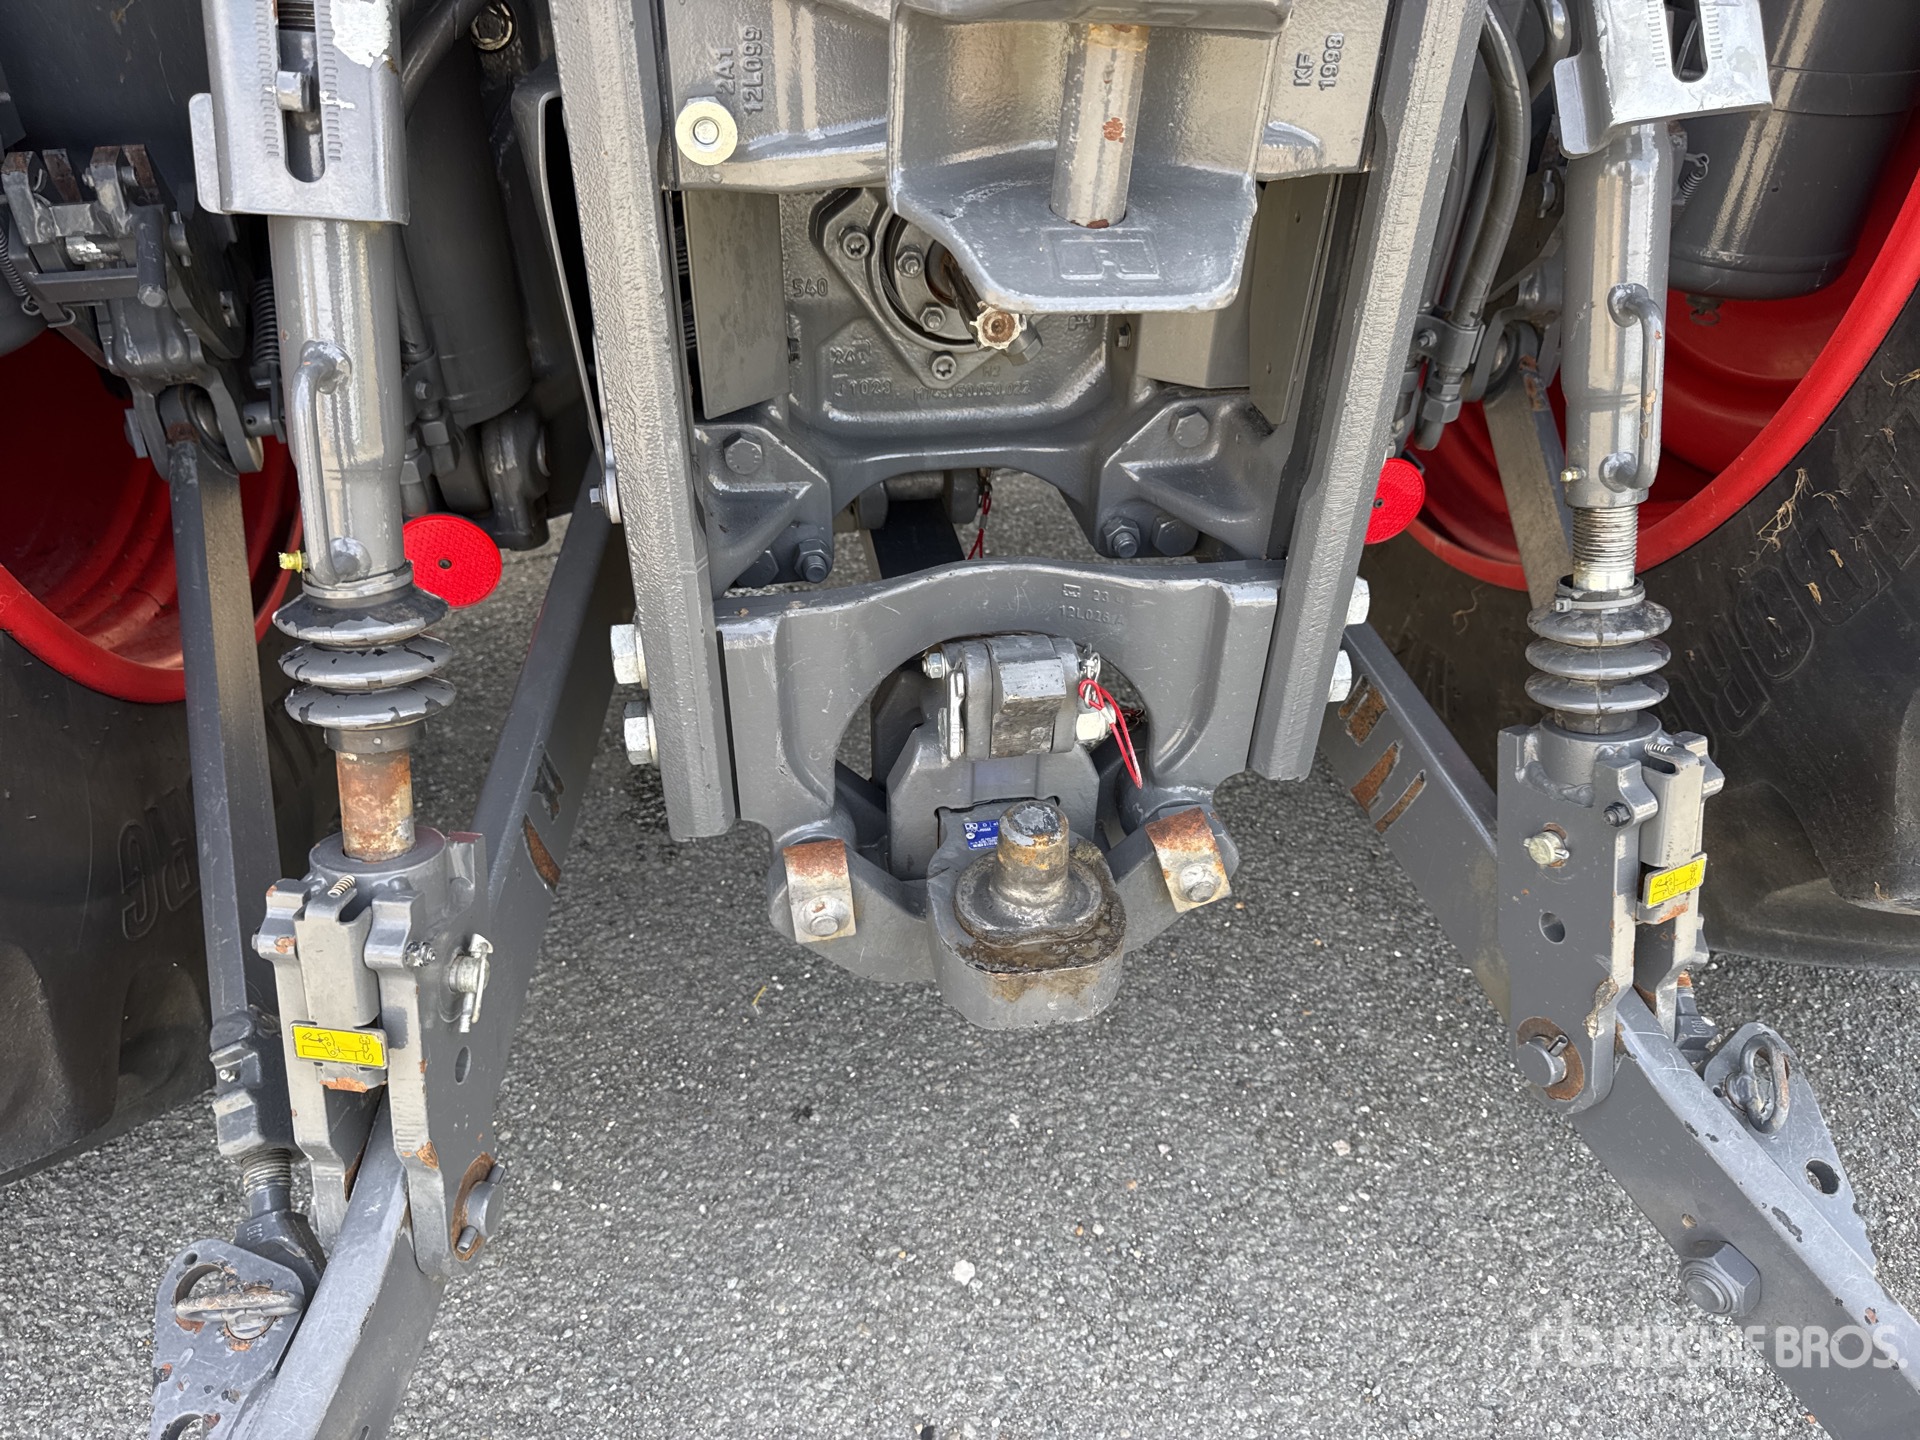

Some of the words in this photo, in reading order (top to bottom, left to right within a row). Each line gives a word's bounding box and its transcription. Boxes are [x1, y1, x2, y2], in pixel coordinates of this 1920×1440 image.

[716, 48, 735, 95] 2A1
[742, 25, 763, 115] 12L099
[1294, 52, 1314, 86] KF
[1319, 32, 1344, 91] 1998
[792, 278, 828, 298] 540
